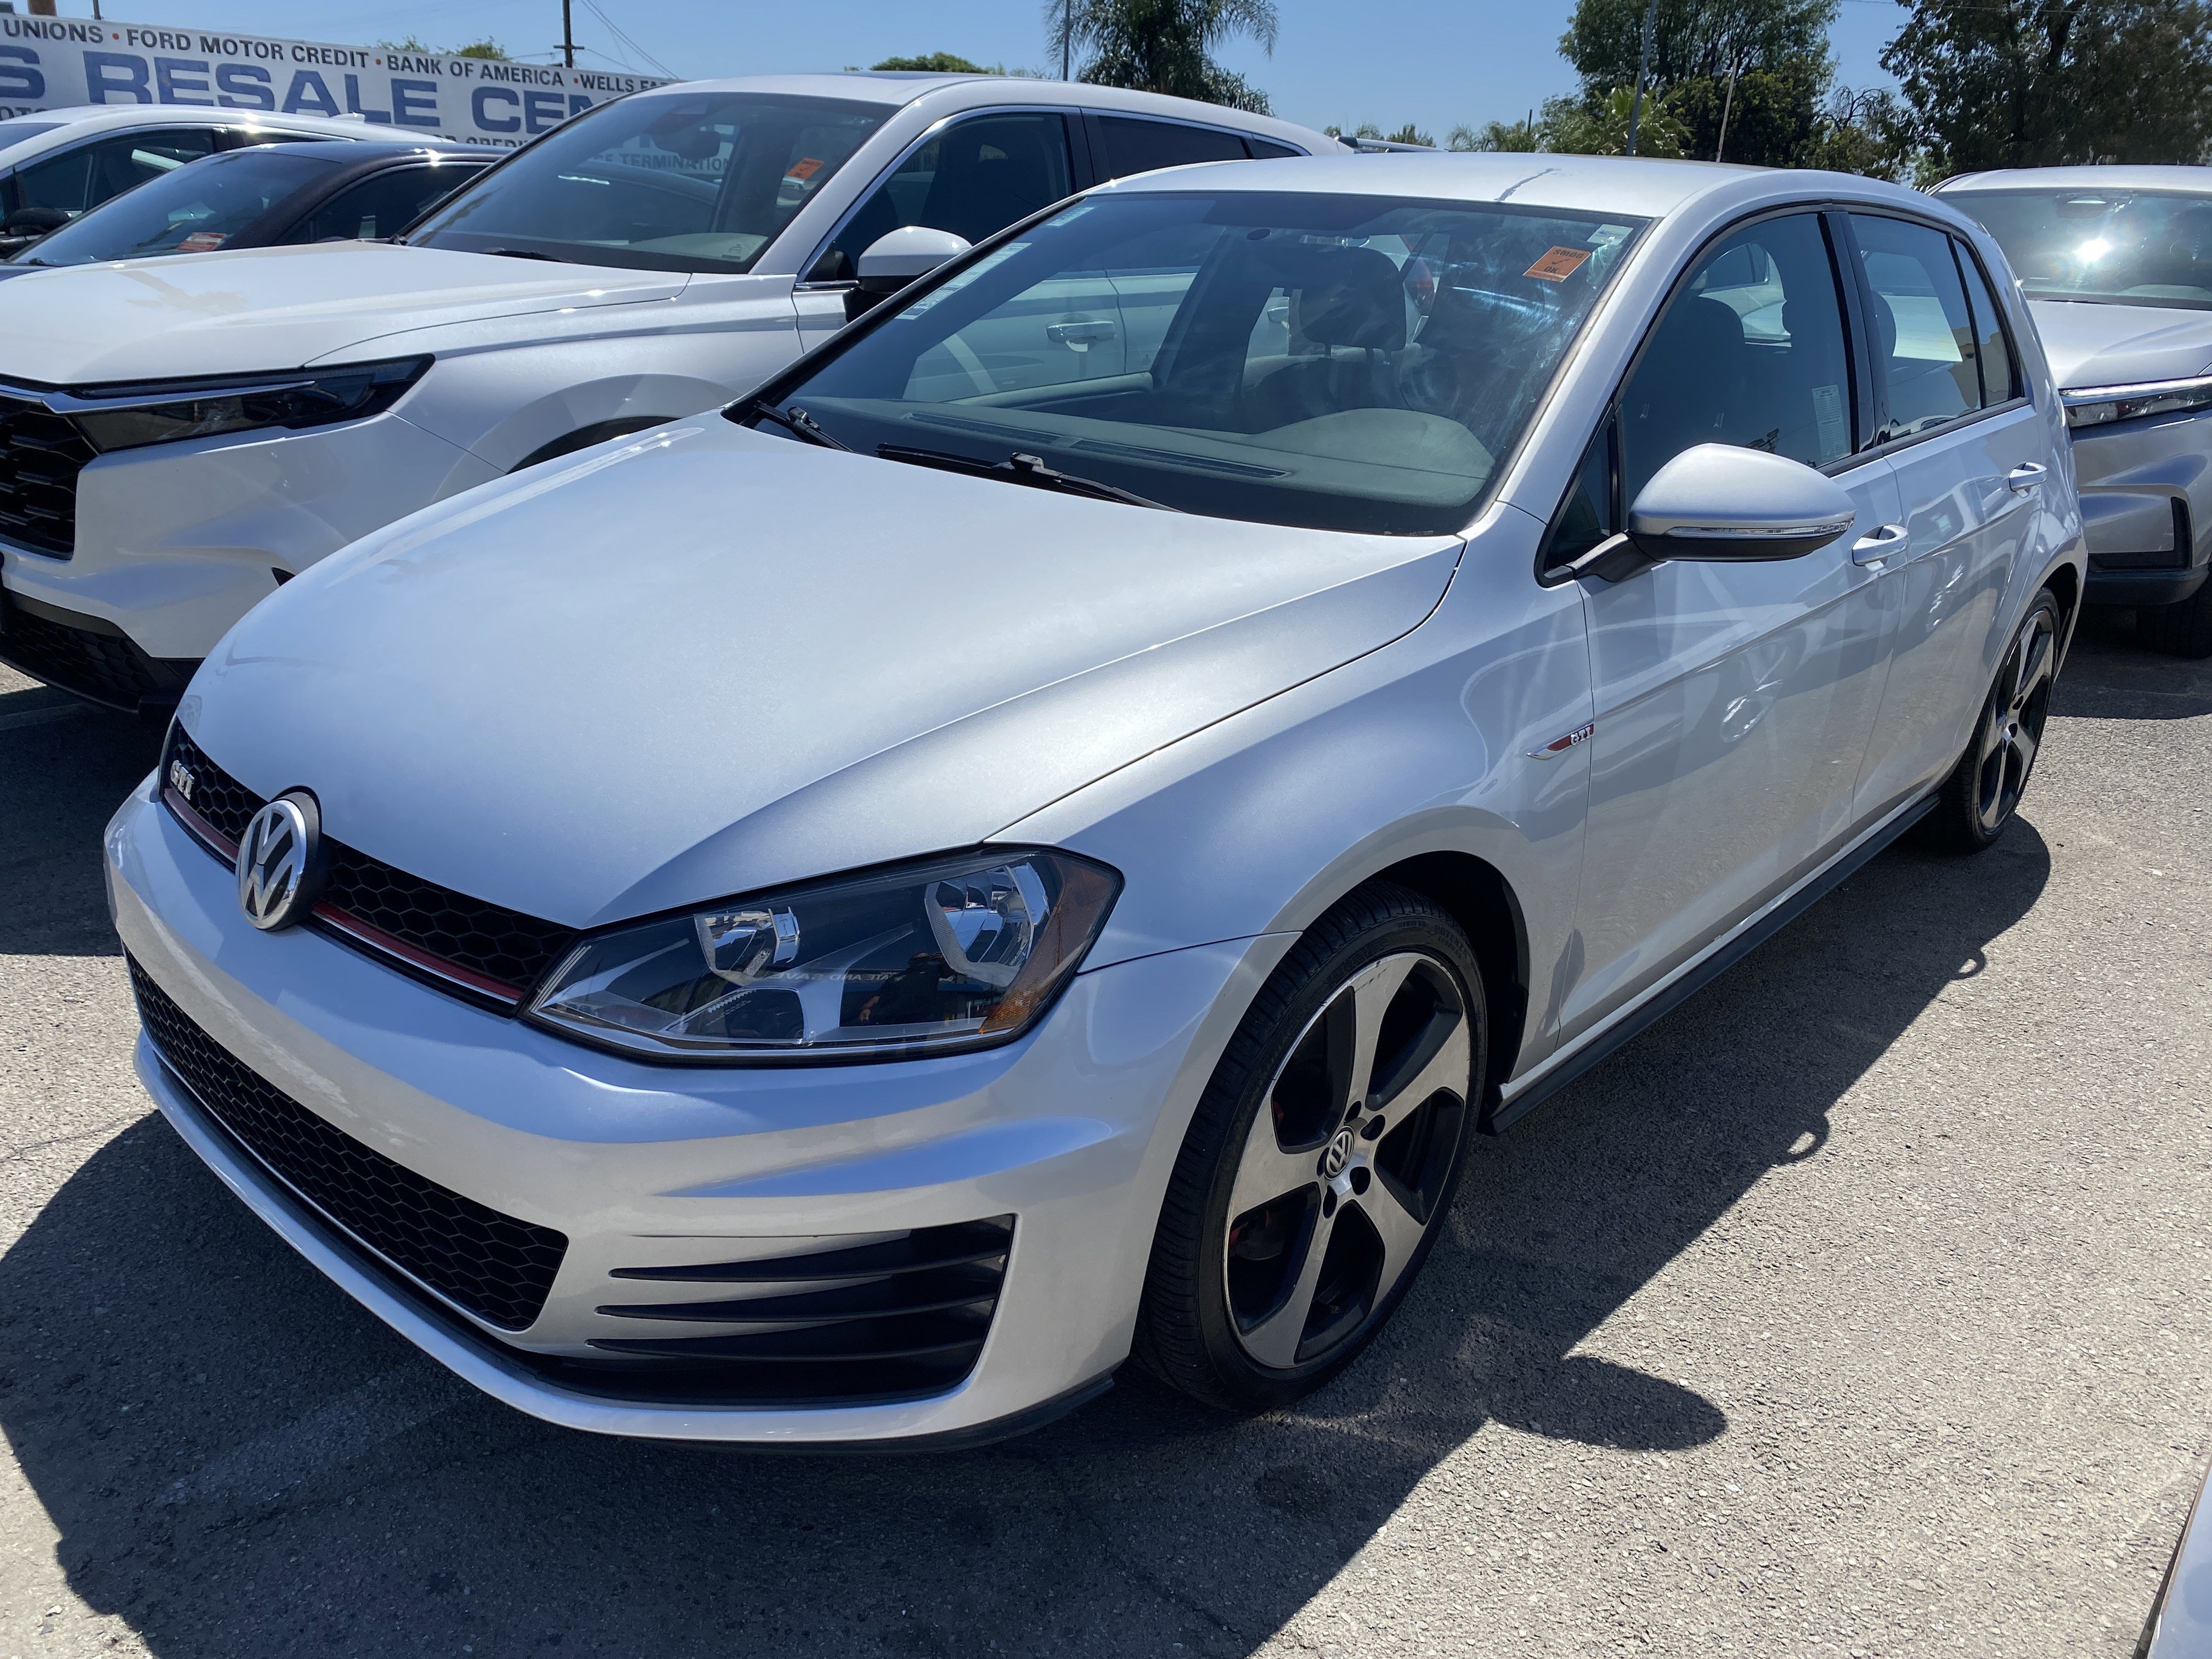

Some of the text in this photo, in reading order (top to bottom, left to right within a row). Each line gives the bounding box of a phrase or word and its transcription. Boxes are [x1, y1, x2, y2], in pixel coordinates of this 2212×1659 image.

[3, 19, 104, 44] UNIONS
[127, 29, 191, 51] FORD
[200, 36, 284, 60] MOTOR
[291, 46, 369, 68] CREDIT
[387, 55, 442, 75] BANK
[449, 61, 474, 78] OF
[480, 64, 565, 86] AMERICA
[579, 74, 634, 93] WELLS
[82, 50, 441, 127] RESALE
[1553, 249, 1585, 259] SMOG
[1571, 726, 1591, 746] GTI
[170, 759, 195, 800] GTI
